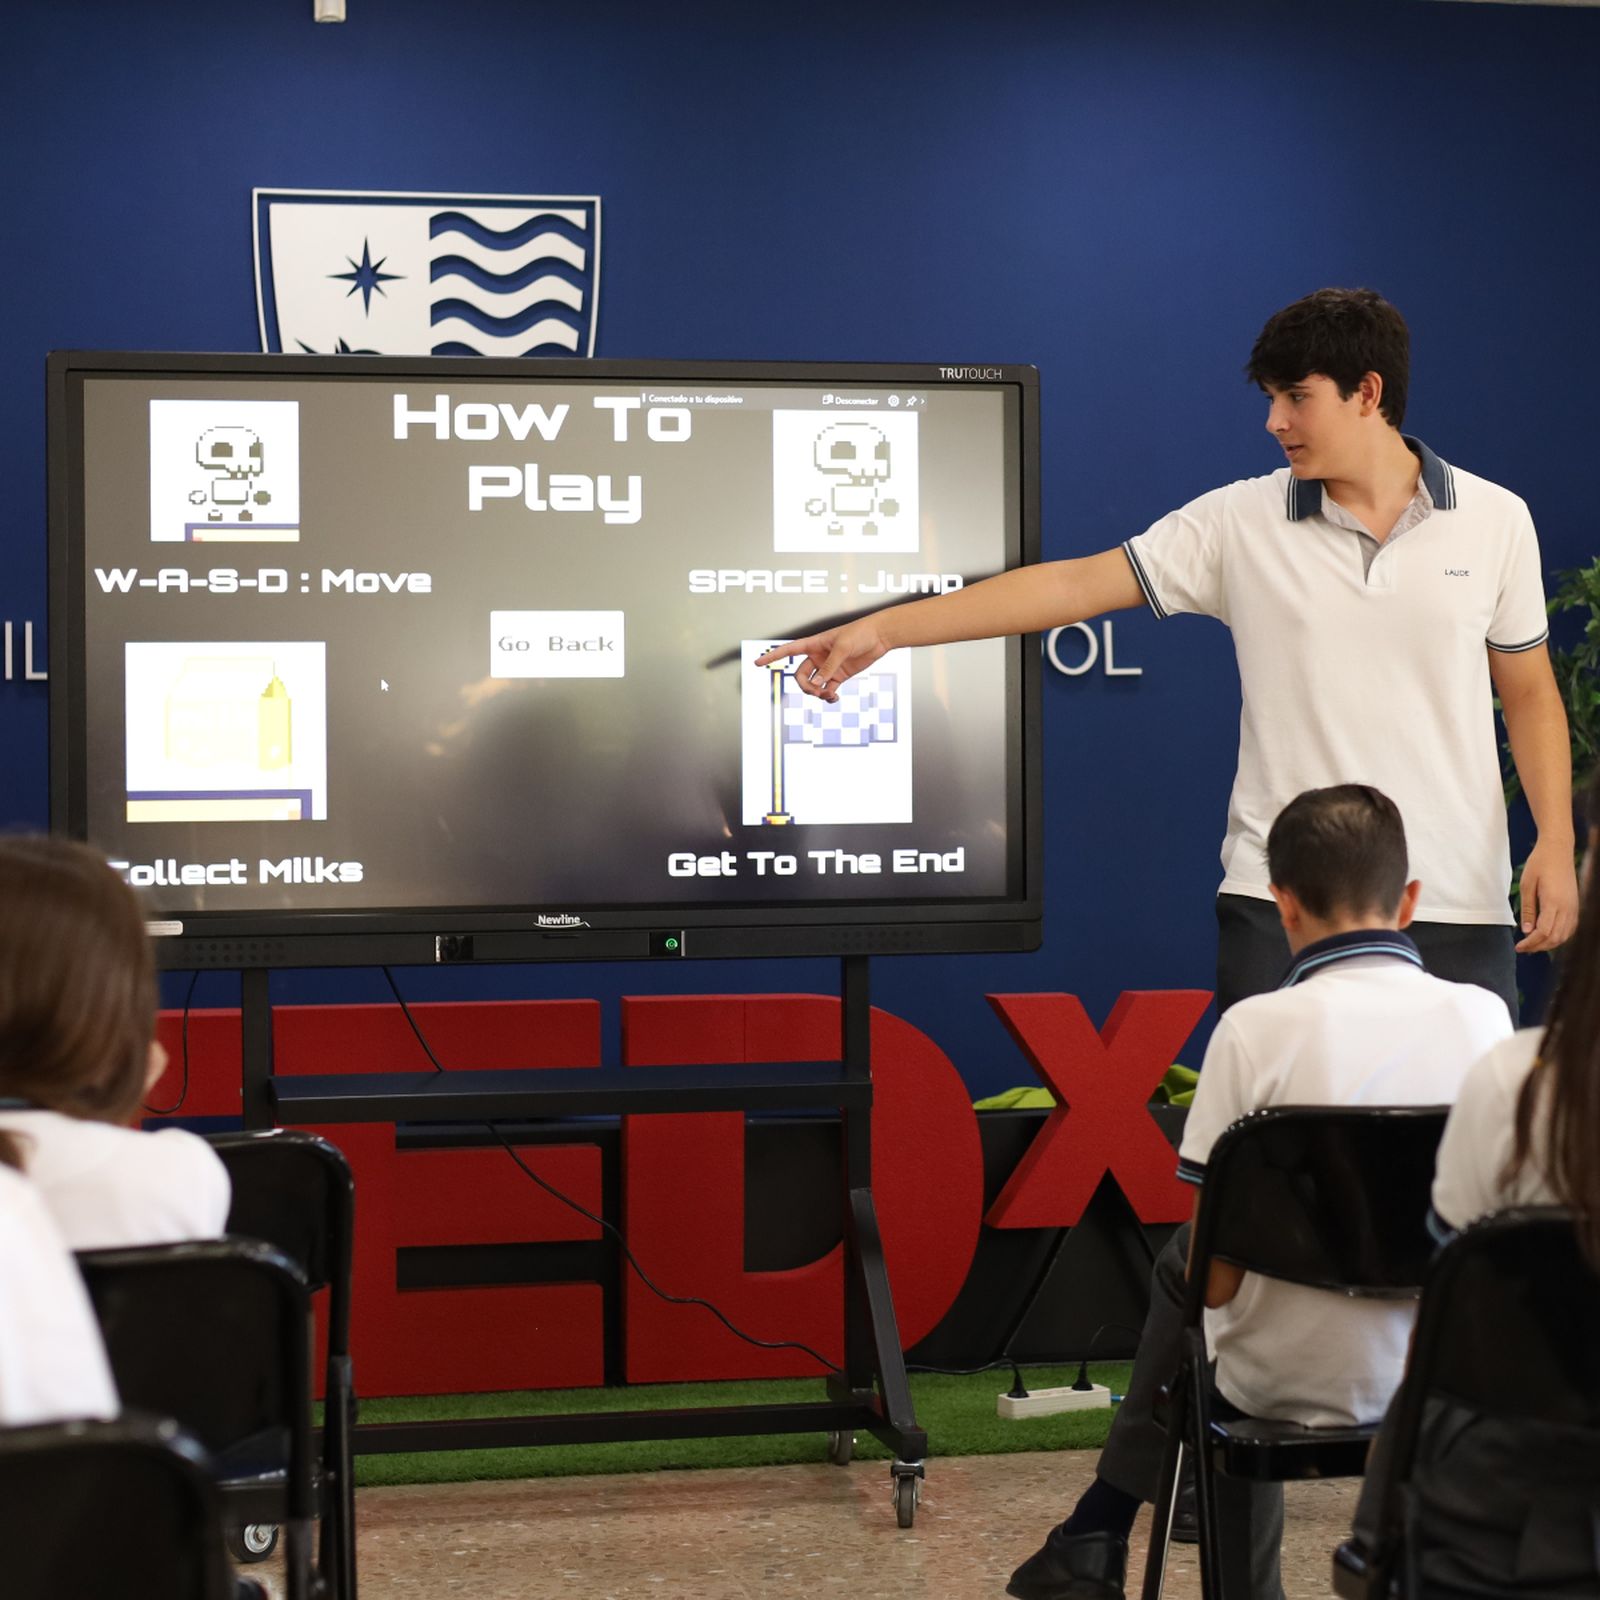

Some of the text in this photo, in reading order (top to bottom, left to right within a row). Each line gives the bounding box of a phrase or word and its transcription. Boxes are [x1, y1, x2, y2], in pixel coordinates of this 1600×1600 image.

[939, 367, 1002, 380] TRUTOUCH
[648, 394, 688, 404] Conectado
[704, 395, 744, 405] dispositivo
[835, 395, 879, 407] Desconectar
[393, 394, 691, 442] How To
[468, 463, 642, 524] Play
[94, 568, 288, 593] W-A-S-D
[321, 569, 432, 593] Move
[688, 569, 829, 593] SPACE
[858, 569, 963, 595] Jump
[1444, 568, 1470, 577] LAUDE
[498, 636, 614, 652] Go Back
[259, 857, 364, 884] Milks
[668, 847, 965, 877] Get To The End
[537, 913, 581, 926] Newline
